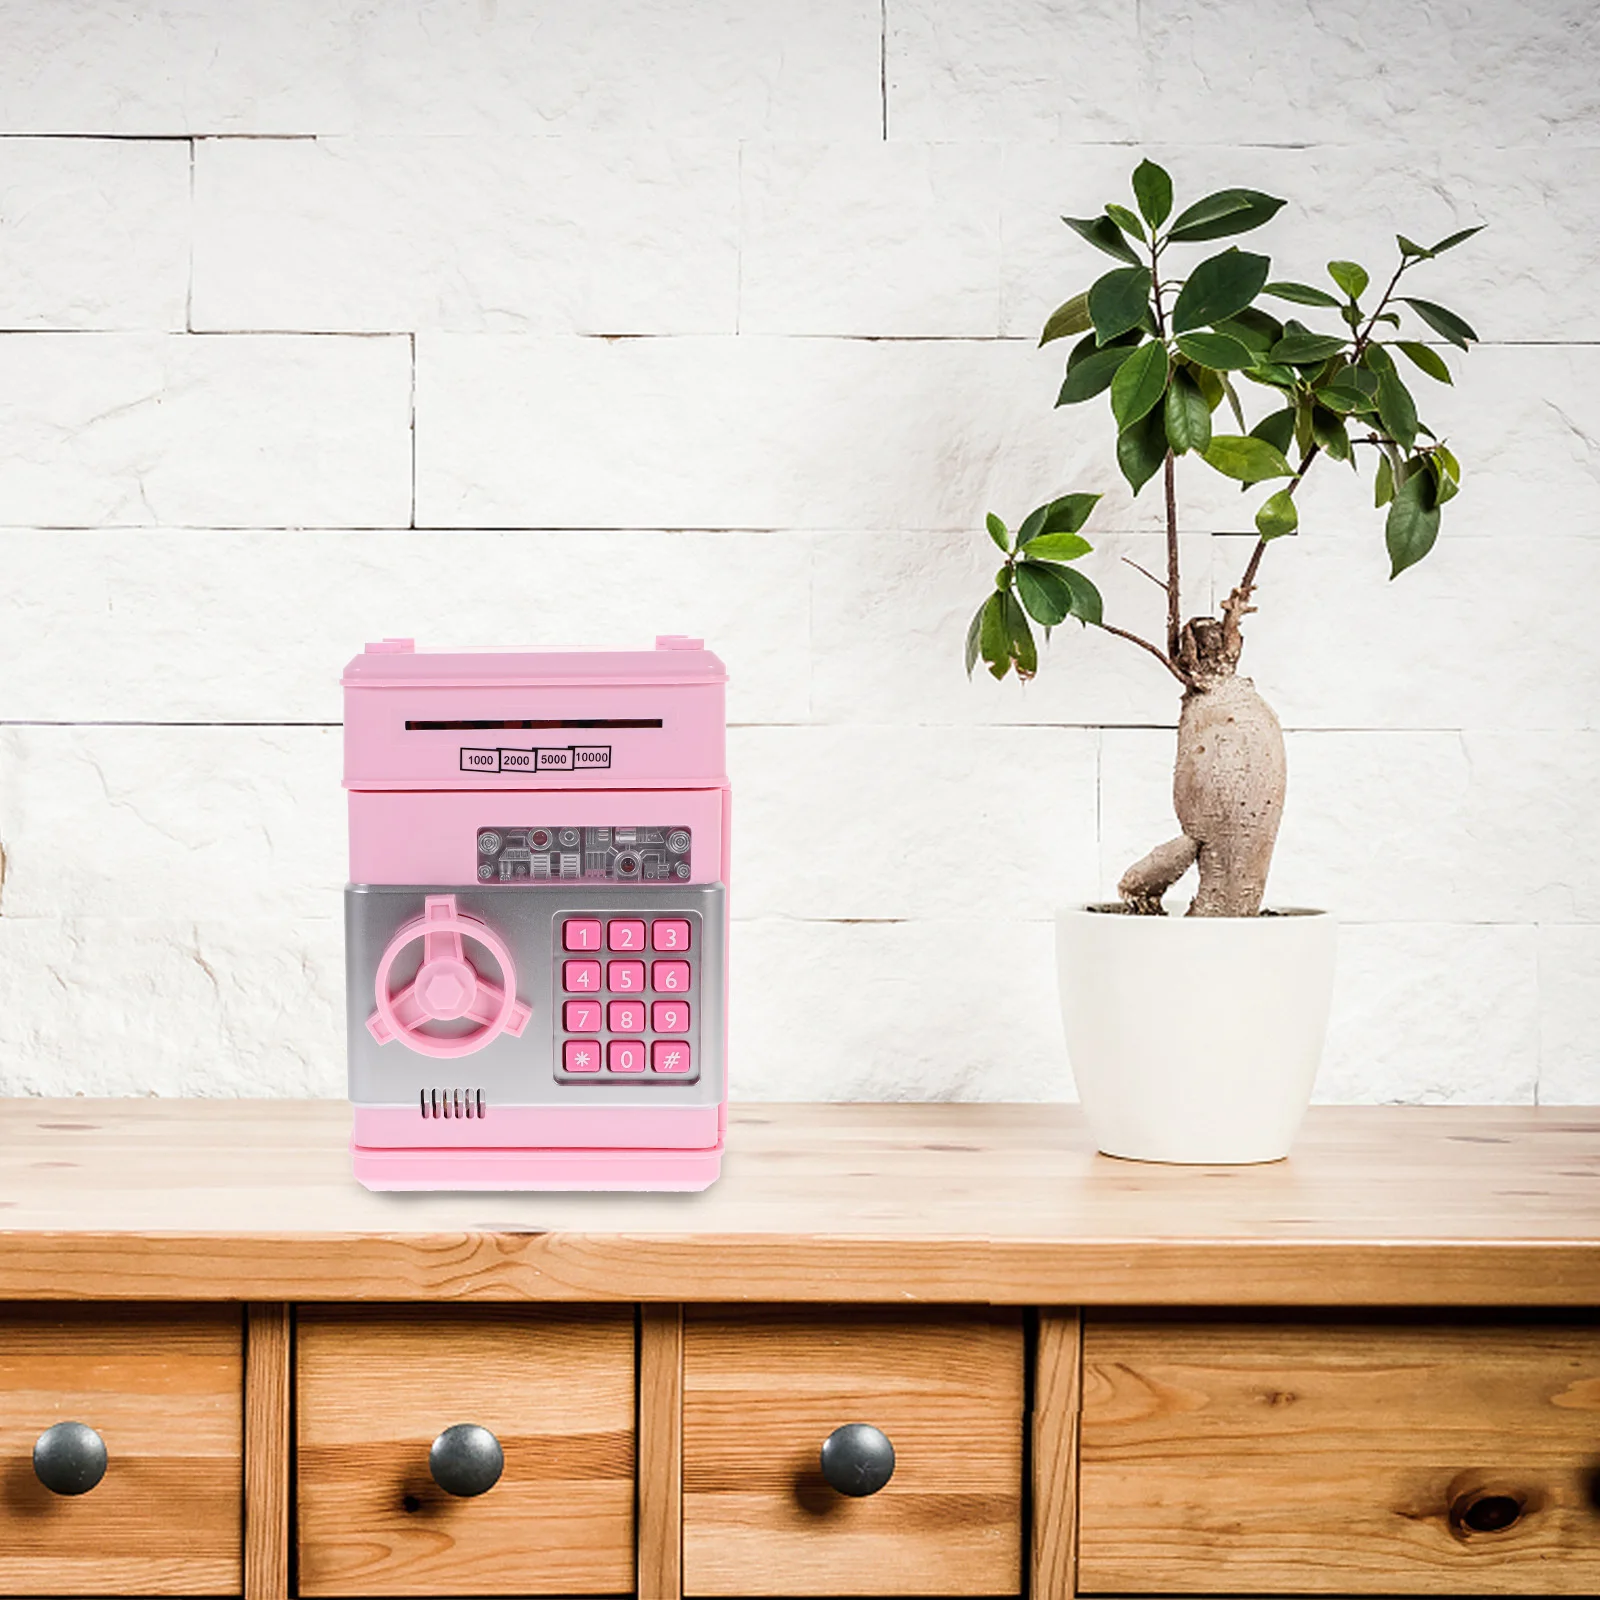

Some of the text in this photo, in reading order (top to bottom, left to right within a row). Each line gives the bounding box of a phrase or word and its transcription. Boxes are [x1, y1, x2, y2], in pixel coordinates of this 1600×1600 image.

[468, 755, 493, 765] 1000
[503, 755, 530, 766] 2000
[540, 754, 567, 765] 5000
[575, 752, 608, 762] 10000
[579, 928, 587, 947] 1
[621, 928, 633, 947] 2
[665, 928, 677, 947] 3
[576, 969, 590, 988] 4
[620, 970, 632, 988] 5
[665, 970, 678, 989] 6
[577, 1010, 590, 1028] 7
[620, 1011, 633, 1029] 8
[664, 1011, 677, 1029] 9
[620, 1050, 633, 1069] 0
